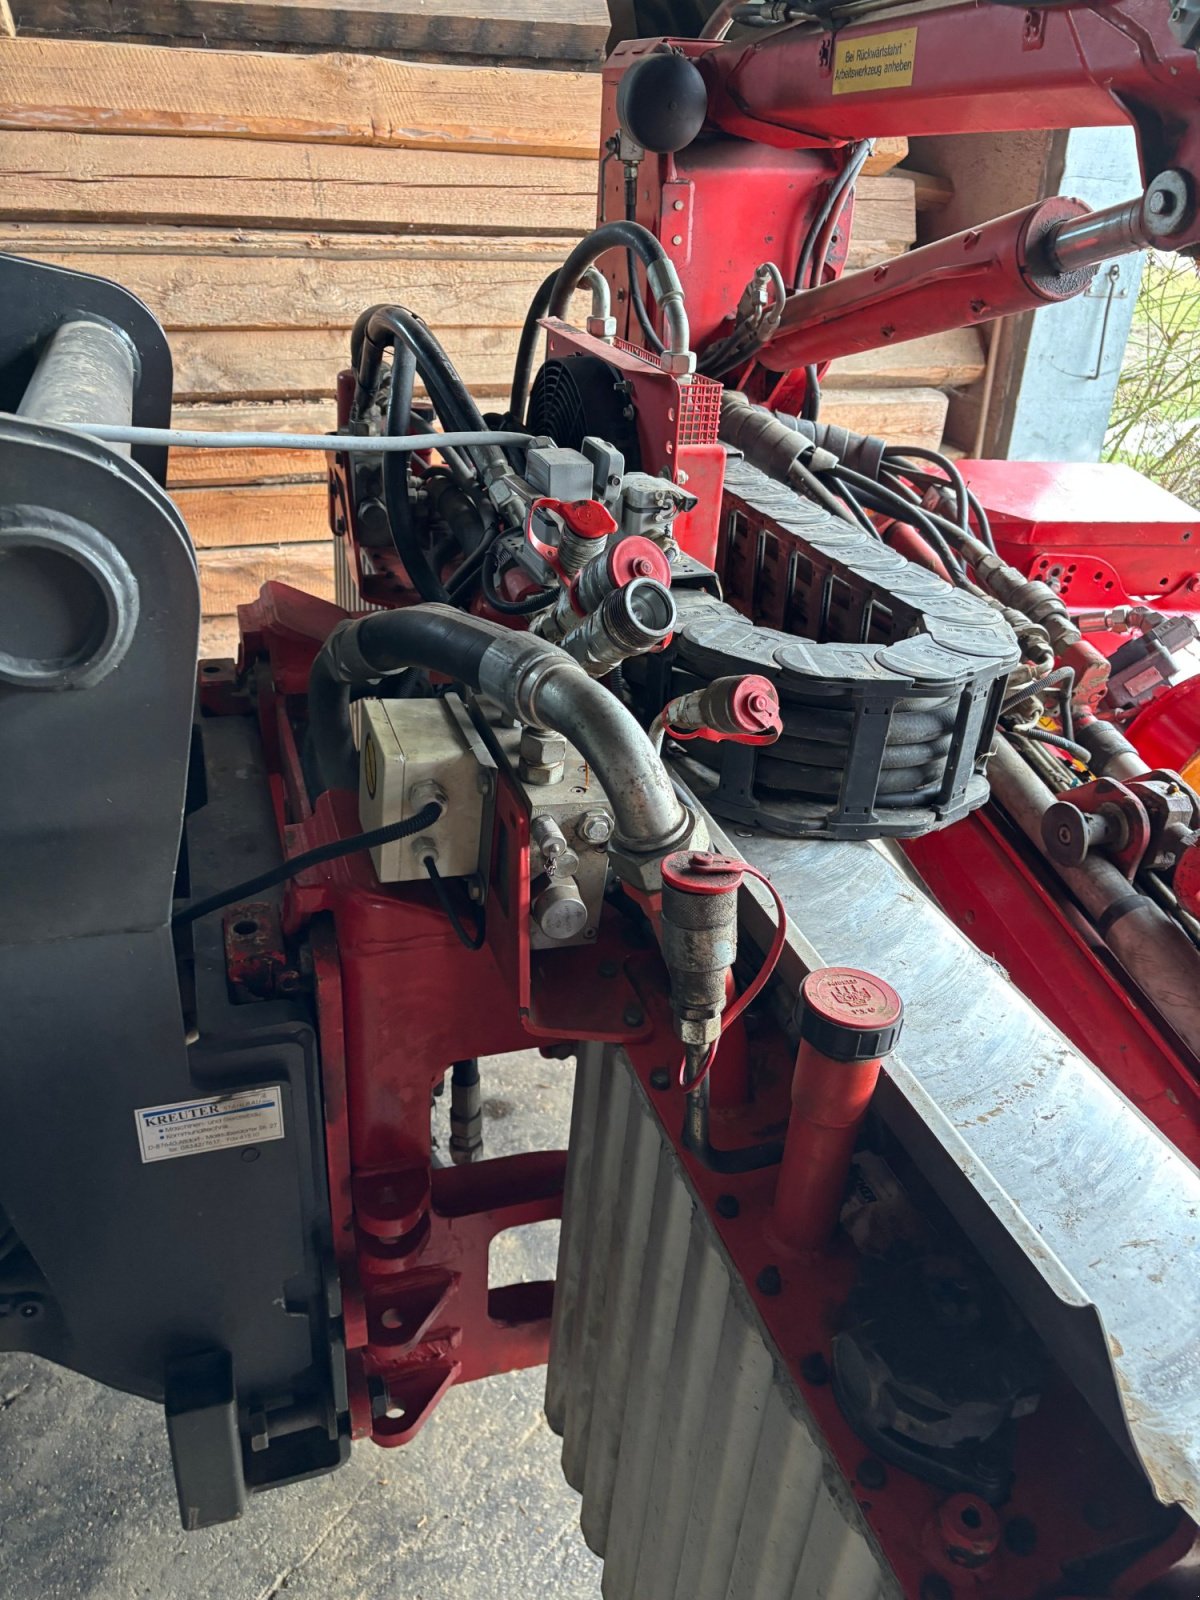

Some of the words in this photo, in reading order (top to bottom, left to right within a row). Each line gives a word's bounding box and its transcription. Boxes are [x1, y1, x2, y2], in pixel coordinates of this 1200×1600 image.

[845, 50, 854, 63] Bei
[856, 43, 903, 61] Rückwärtsfahrt
[835, 65, 882, 81] Arbeitswerkzeug
[884, 59, 912, 74] anheben
[145, 1104, 220, 1127] KREUTER
[207, 1117, 222, 1126] und
